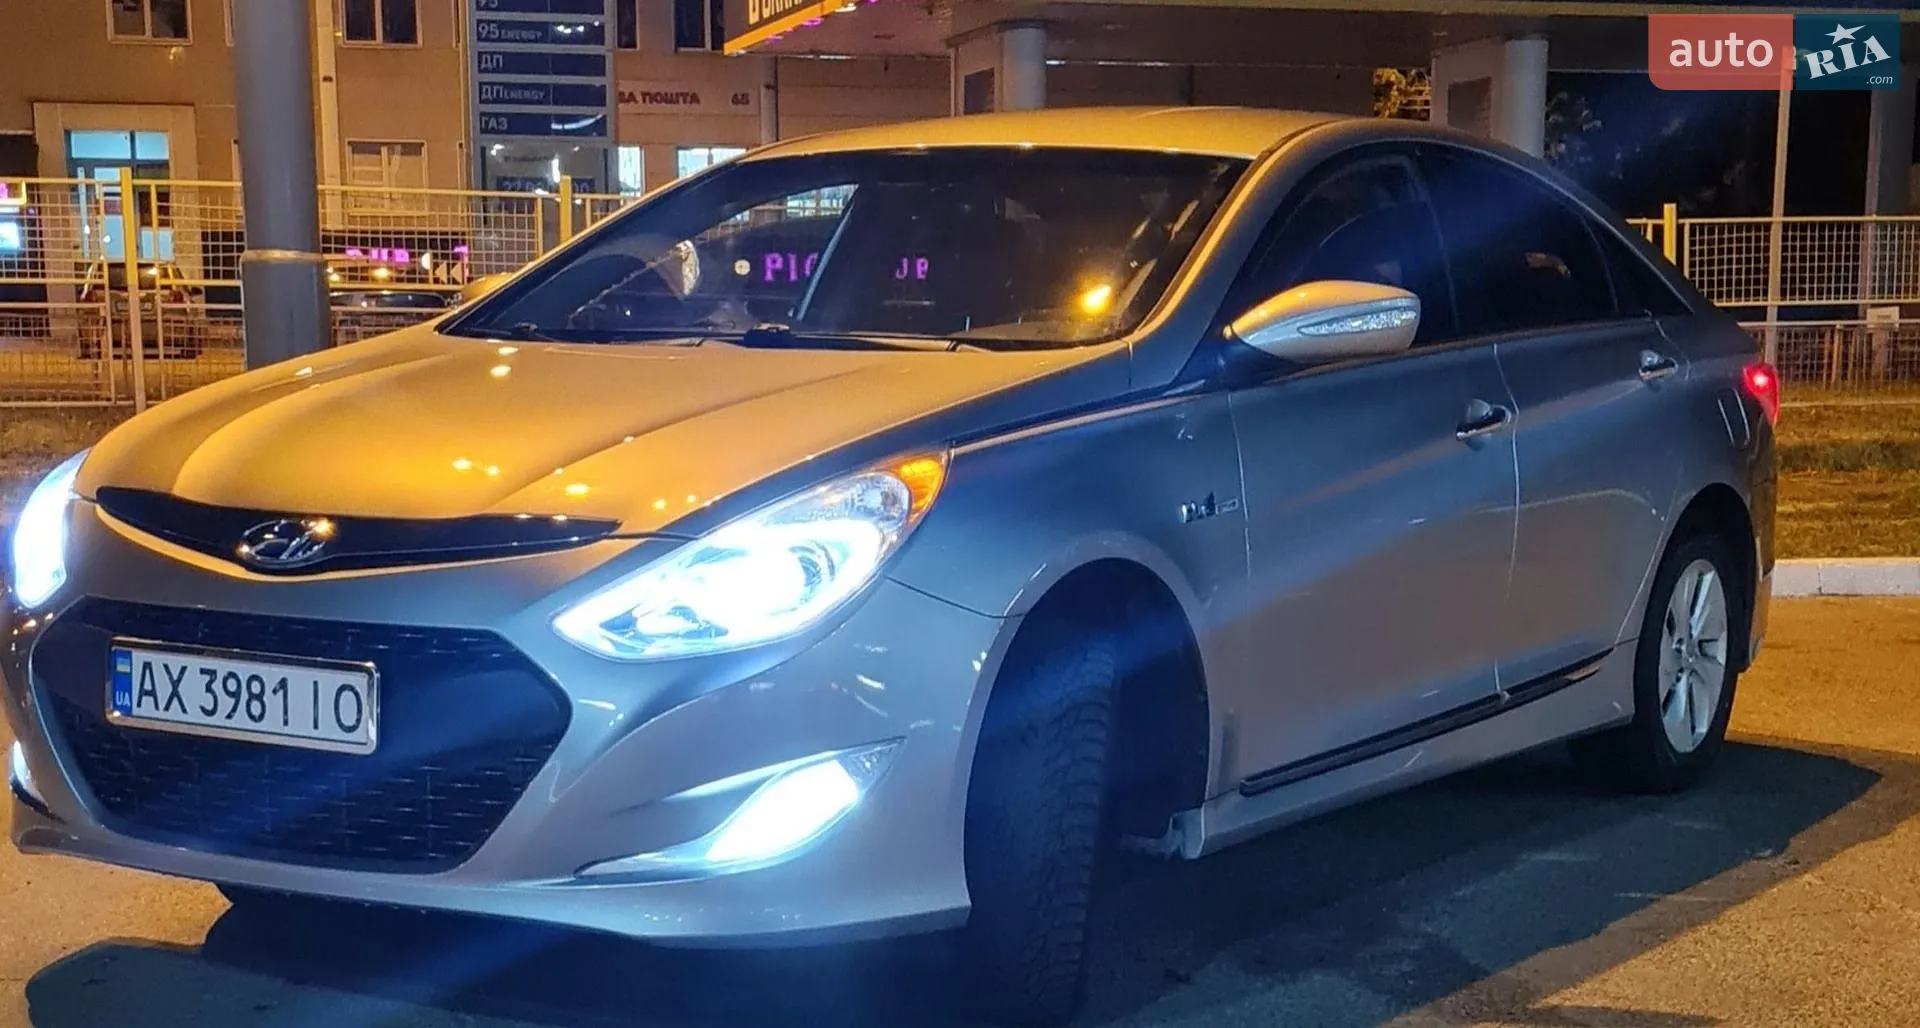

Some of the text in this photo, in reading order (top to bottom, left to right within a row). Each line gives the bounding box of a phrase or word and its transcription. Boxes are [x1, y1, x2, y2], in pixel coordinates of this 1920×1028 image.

[478, 23, 499, 39] 95
[481, 54, 503, 71] ДП
[641, 91, 700, 105] ПОШТА
[481, 116, 508, 131] ГАЗ
[116, 691, 130, 708] UA
[199, 667, 289, 727] 3981
